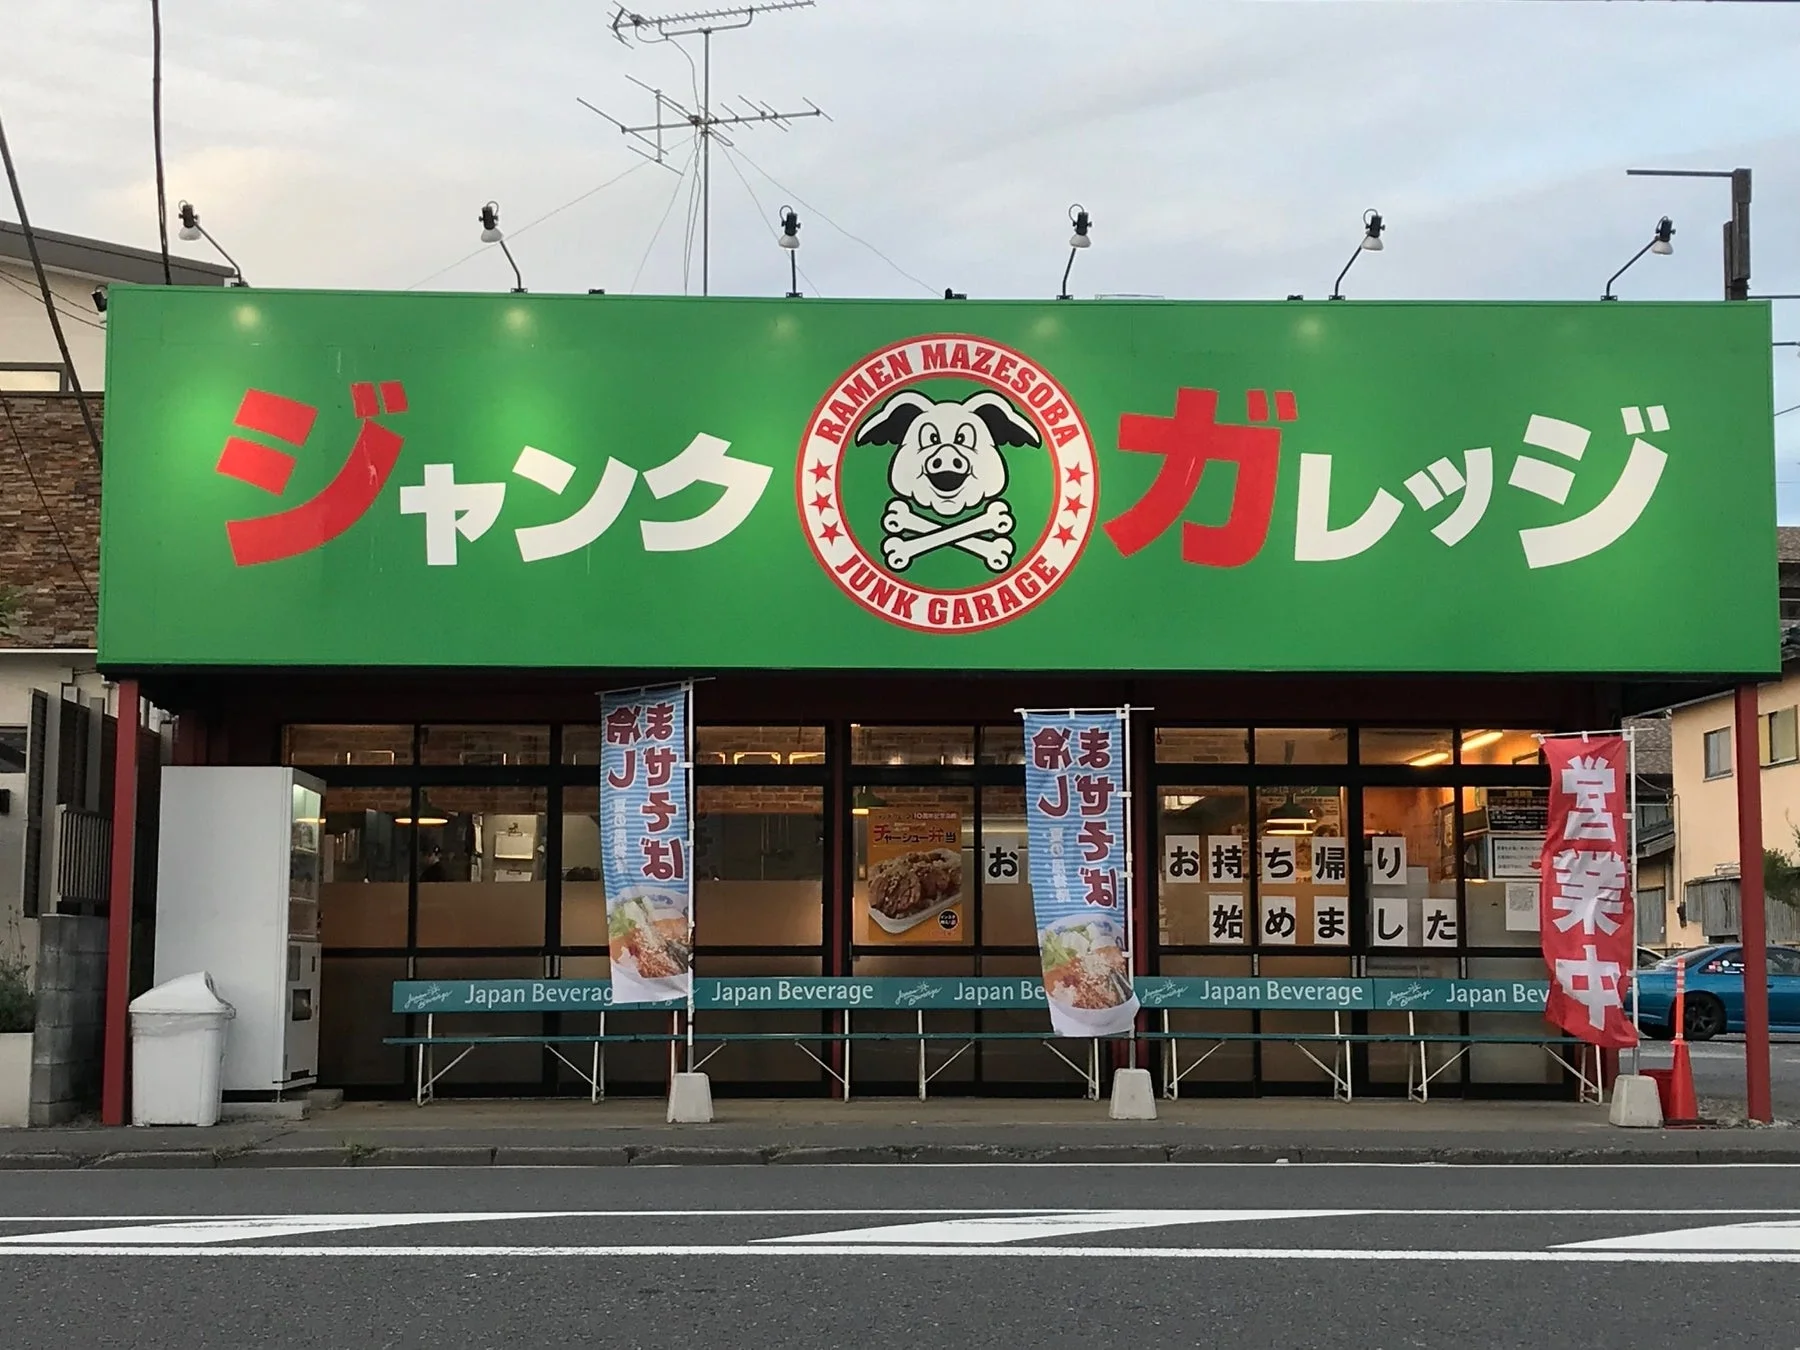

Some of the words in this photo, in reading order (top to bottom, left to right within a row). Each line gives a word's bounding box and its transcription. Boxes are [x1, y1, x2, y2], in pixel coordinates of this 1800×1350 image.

[815, 350, 913, 445] RAMEN
[921, 343, 1081, 448] MAZESOBA
[216, 380, 773, 566] ジャンク
[1102, 386, 1670, 569] ガレッジ
[836, 554, 919, 620] JUNK
[927, 554, 1060, 625] GARAGE
[873, 824, 957, 844] チャーシュー弁当
[1169, 845, 1402, 880] お持ち帰り
[1552, 755, 1626, 1032] 営業中
[1212, 904, 1457, 941] 始めました
[464, 983, 525, 1010] Japan
[712, 981, 771, 1006] Japan
[778, 980, 874, 1004] Beverage
[954, 982, 1014, 1005] Japan
[1200, 980, 1261, 1006] Japan
[1267, 980, 1363, 1006] Beverage
[1446, 983, 1506, 1008] Japan
